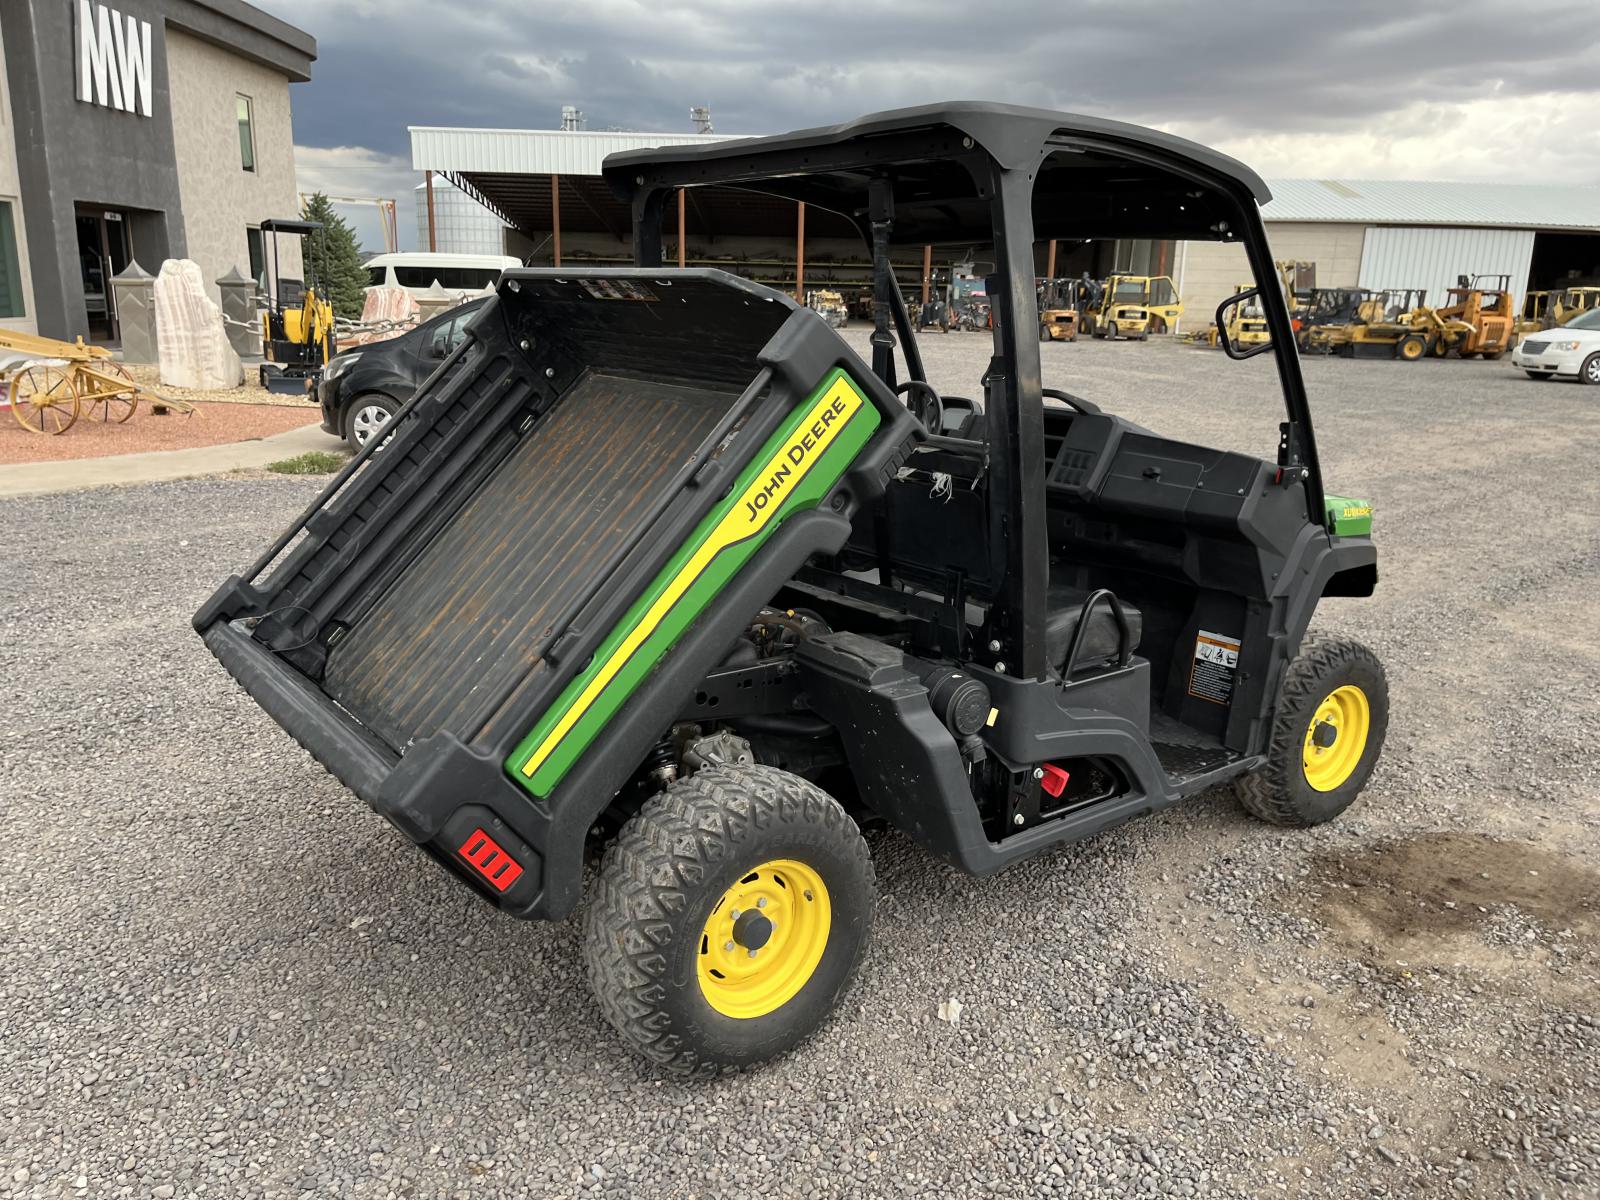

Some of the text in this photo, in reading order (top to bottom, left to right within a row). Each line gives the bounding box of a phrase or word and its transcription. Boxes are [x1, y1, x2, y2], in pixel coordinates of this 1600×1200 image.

[77, 0, 152, 117] MW
[745, 396, 846, 523] JOHN DEERE
